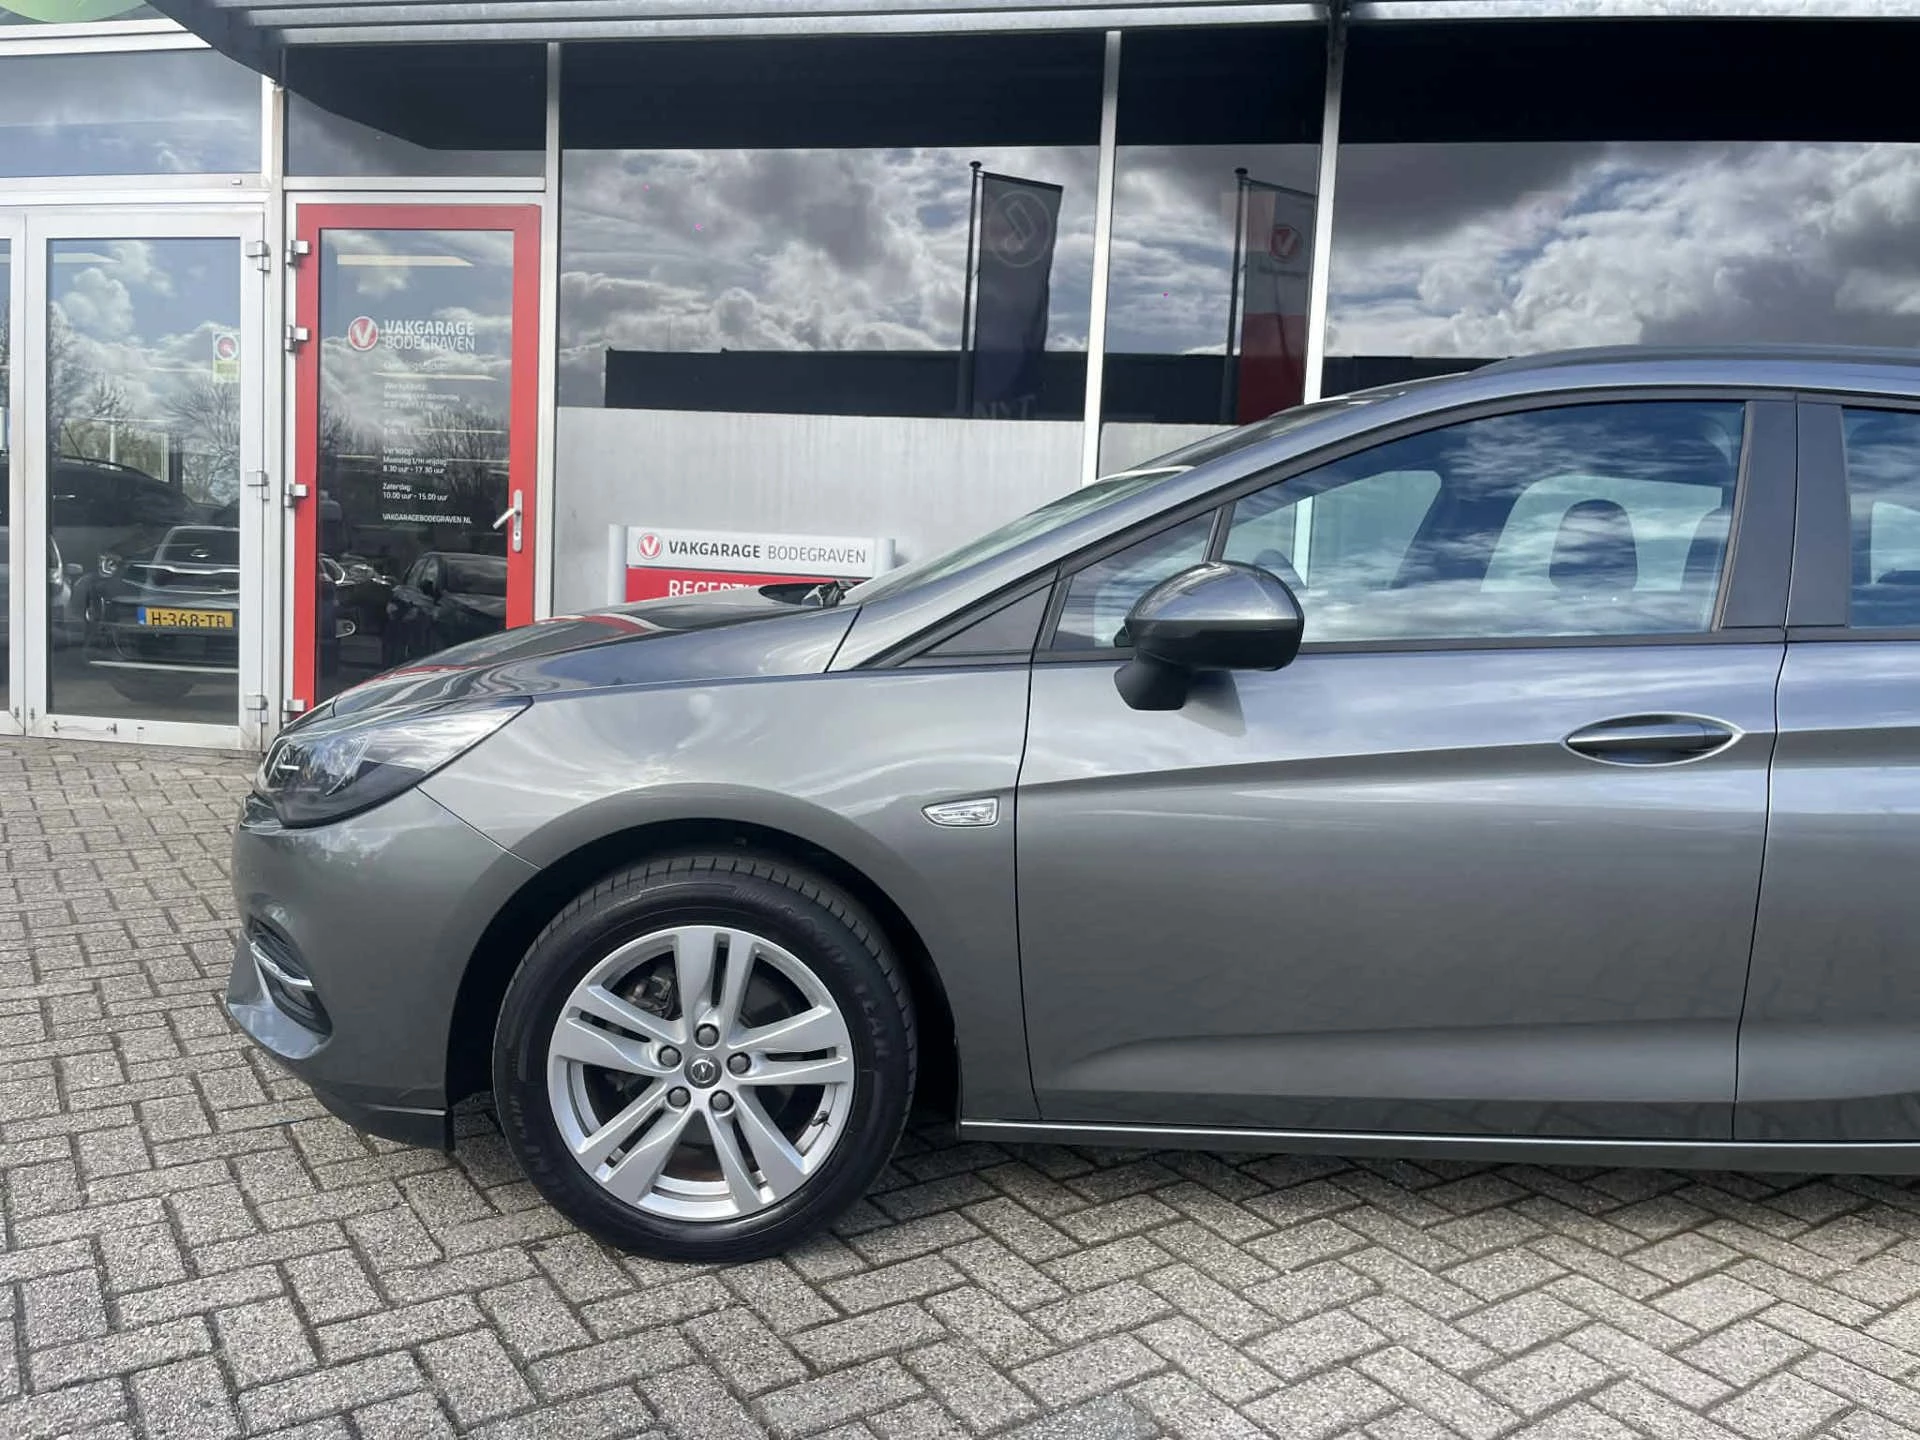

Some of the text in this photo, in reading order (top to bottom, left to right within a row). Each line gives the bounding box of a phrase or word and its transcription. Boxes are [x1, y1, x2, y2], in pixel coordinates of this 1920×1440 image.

[383, 319, 475, 336] VAKGARAGE
[385, 335, 475, 351] BODEGRAVEN
[669, 541, 866, 564] VAKGARAGE BODEGRAVEN
[669, 579, 752, 598] RECE
